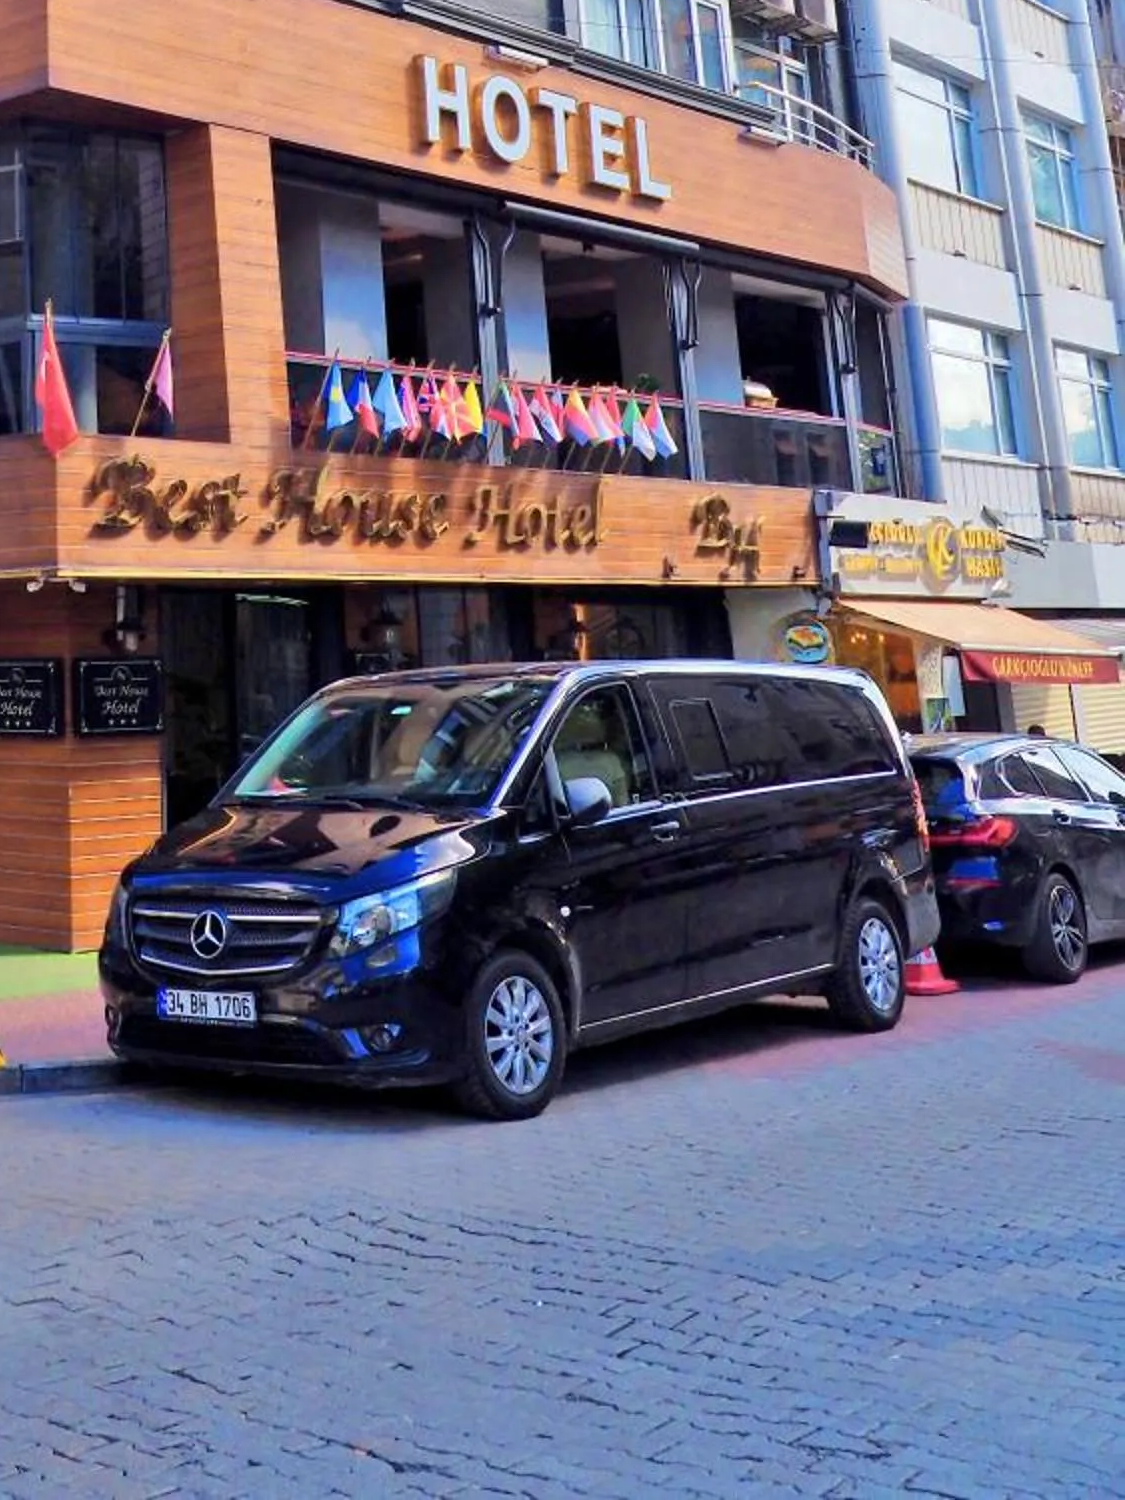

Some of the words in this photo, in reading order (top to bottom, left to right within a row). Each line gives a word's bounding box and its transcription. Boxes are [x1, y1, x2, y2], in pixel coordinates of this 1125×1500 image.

[419, 53, 672, 201] HOTEL
[92, 454, 249, 538] Best
[262, 465, 451, 546] House
[464, 472, 611, 552] Hotel
[0, 699, 36, 717] Hotel
[102, 698, 142, 715] Hotel
[168, 991, 184, 1013] 34
[190, 993, 208, 1015] BH
[215, 995, 252, 1019] 1706
